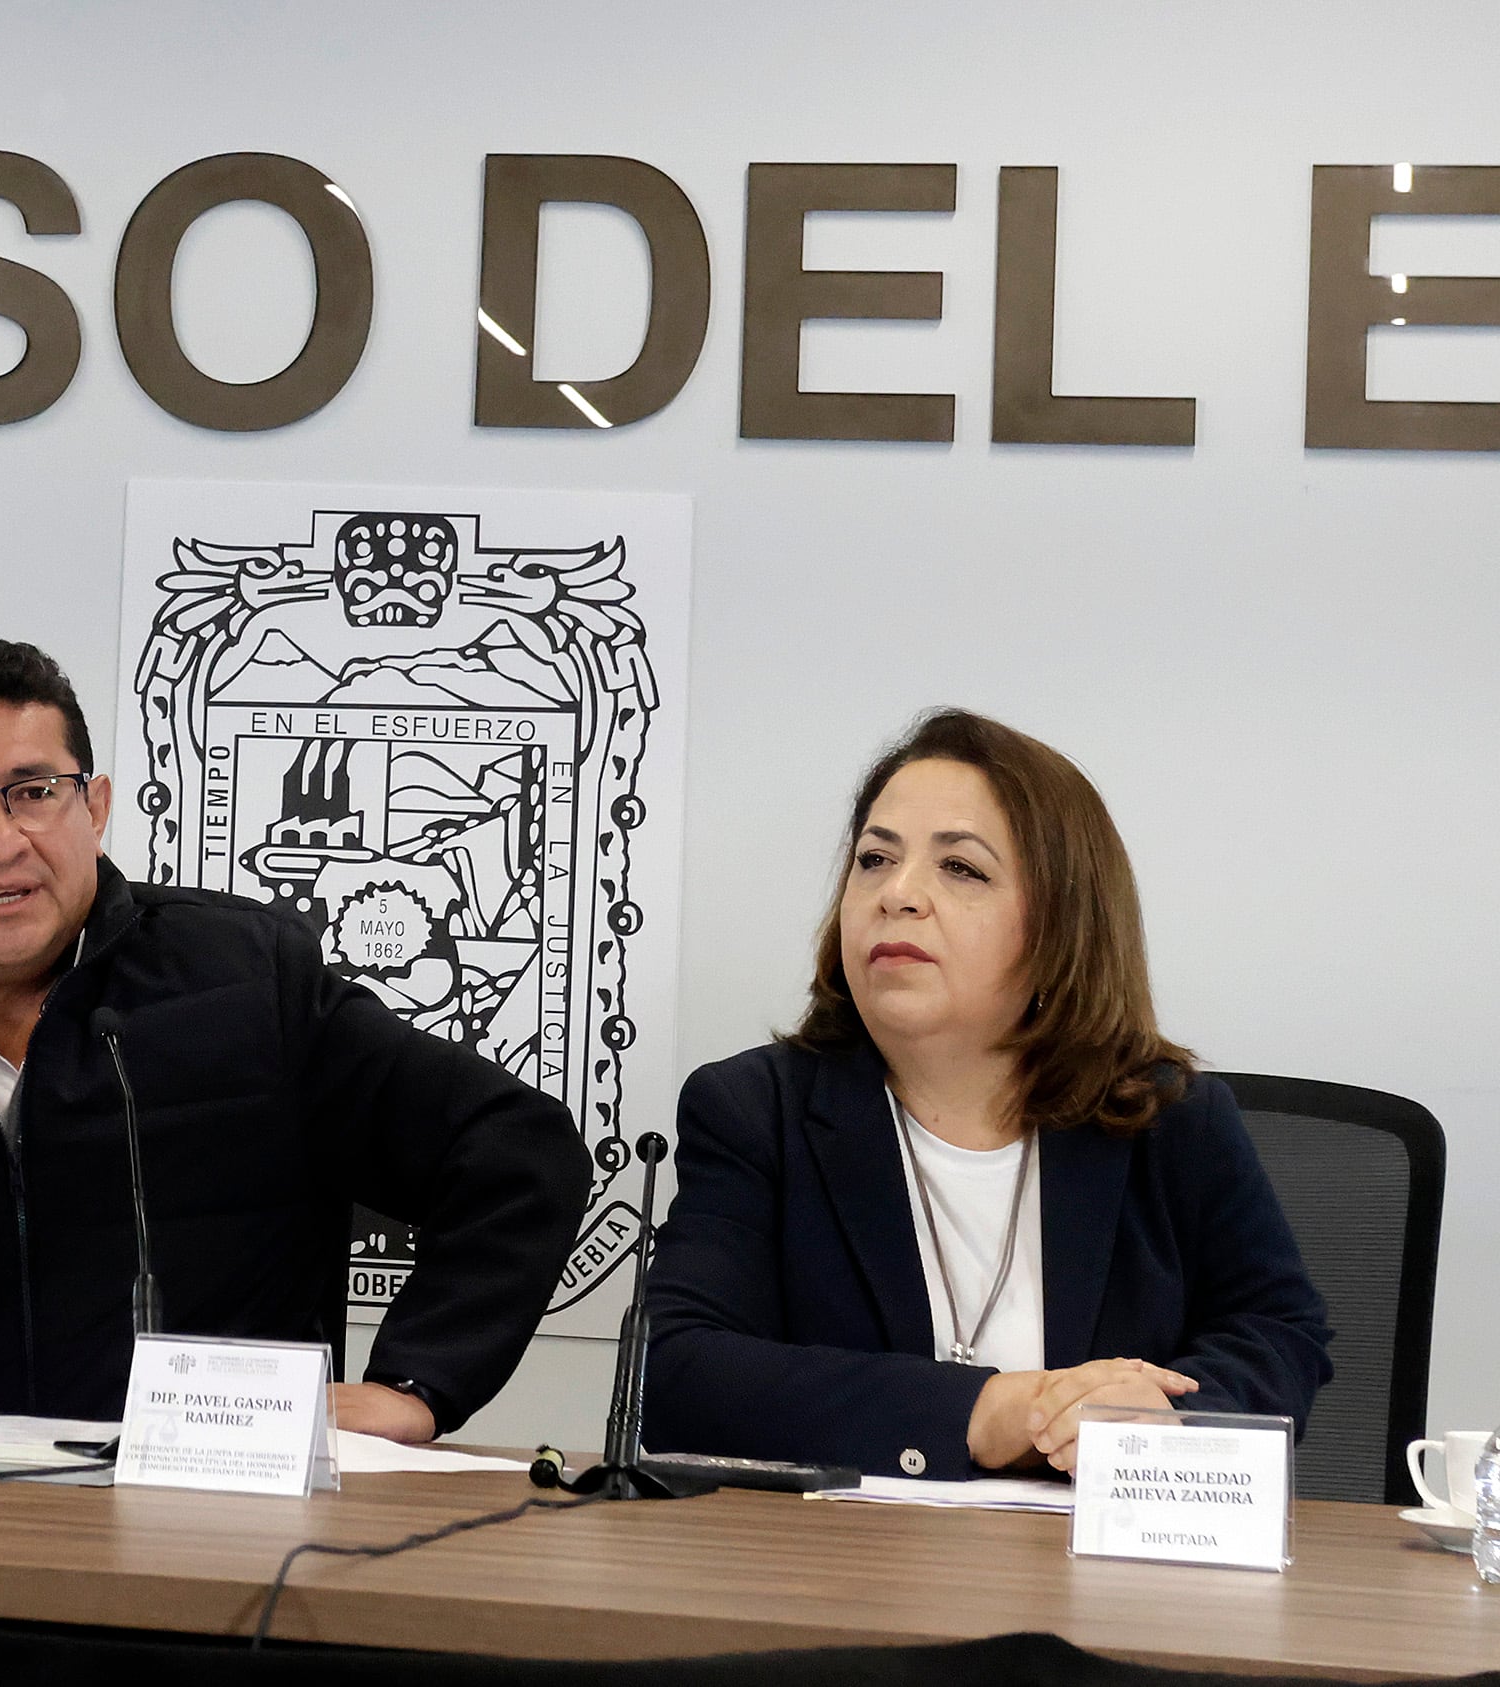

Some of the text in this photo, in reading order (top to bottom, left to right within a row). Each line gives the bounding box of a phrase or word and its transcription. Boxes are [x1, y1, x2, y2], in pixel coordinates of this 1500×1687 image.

[474, 153, 1198, 448] DEL
[1304, 163, 1500, 453] E
[251, 712, 537, 742] EN EL ESFUERZO
[204, 745, 231, 861] TIEMPO
[379, 898, 389, 915] 5
[359, 920, 406, 938] MAYO
[541, 761, 573, 1080] EN LA JUSTICIA
[364, 942, 404, 959] 1862
[350, 1219, 631, 1298] OBE UEBLA
[150, 1391, 293, 1412] DIP. PAVEL GASPAR
[185, 1410, 254, 1427] RAMÍREZ
[130, 1444, 180, 1455] PRESIDENTE
[1113, 1466, 1252, 1486] MARÍA SOLEDAD
[1110, 1487, 1254, 1505] AMIEVA ZAMORA
[1141, 1531, 1218, 1547] DIPUTADA
